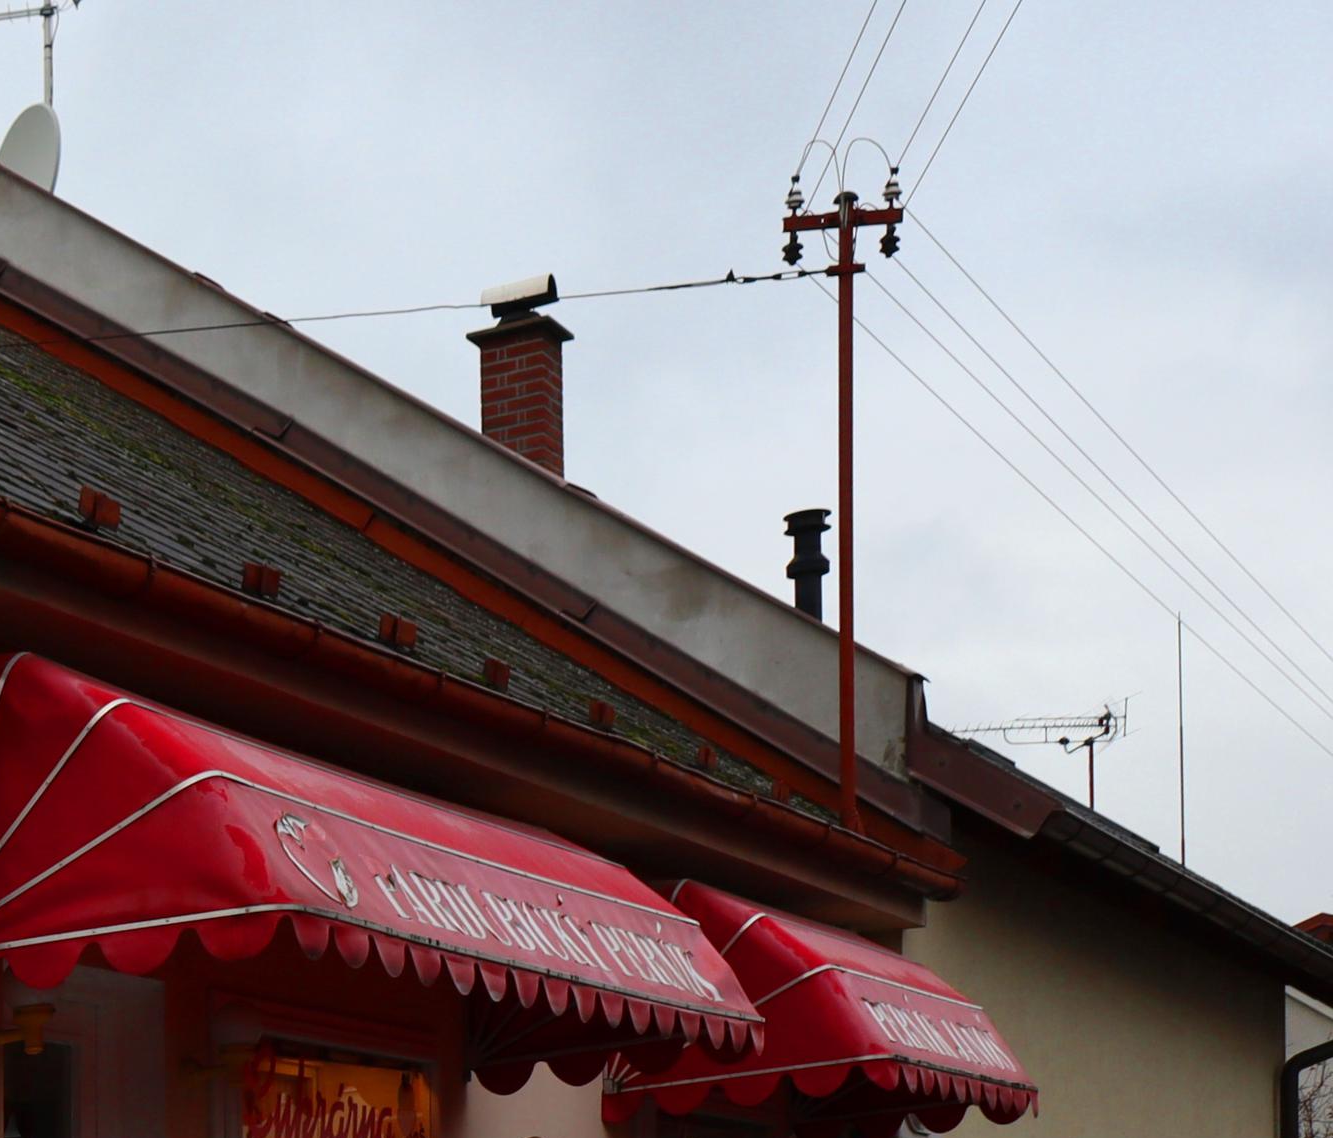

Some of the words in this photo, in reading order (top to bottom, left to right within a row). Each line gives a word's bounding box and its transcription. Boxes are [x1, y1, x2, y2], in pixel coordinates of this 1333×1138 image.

[373, 863, 612, 972] PARDUBICKÝ
[588, 921, 725, 1001] PERNÍK
[863, 994, 960, 1059] PERNÍK
